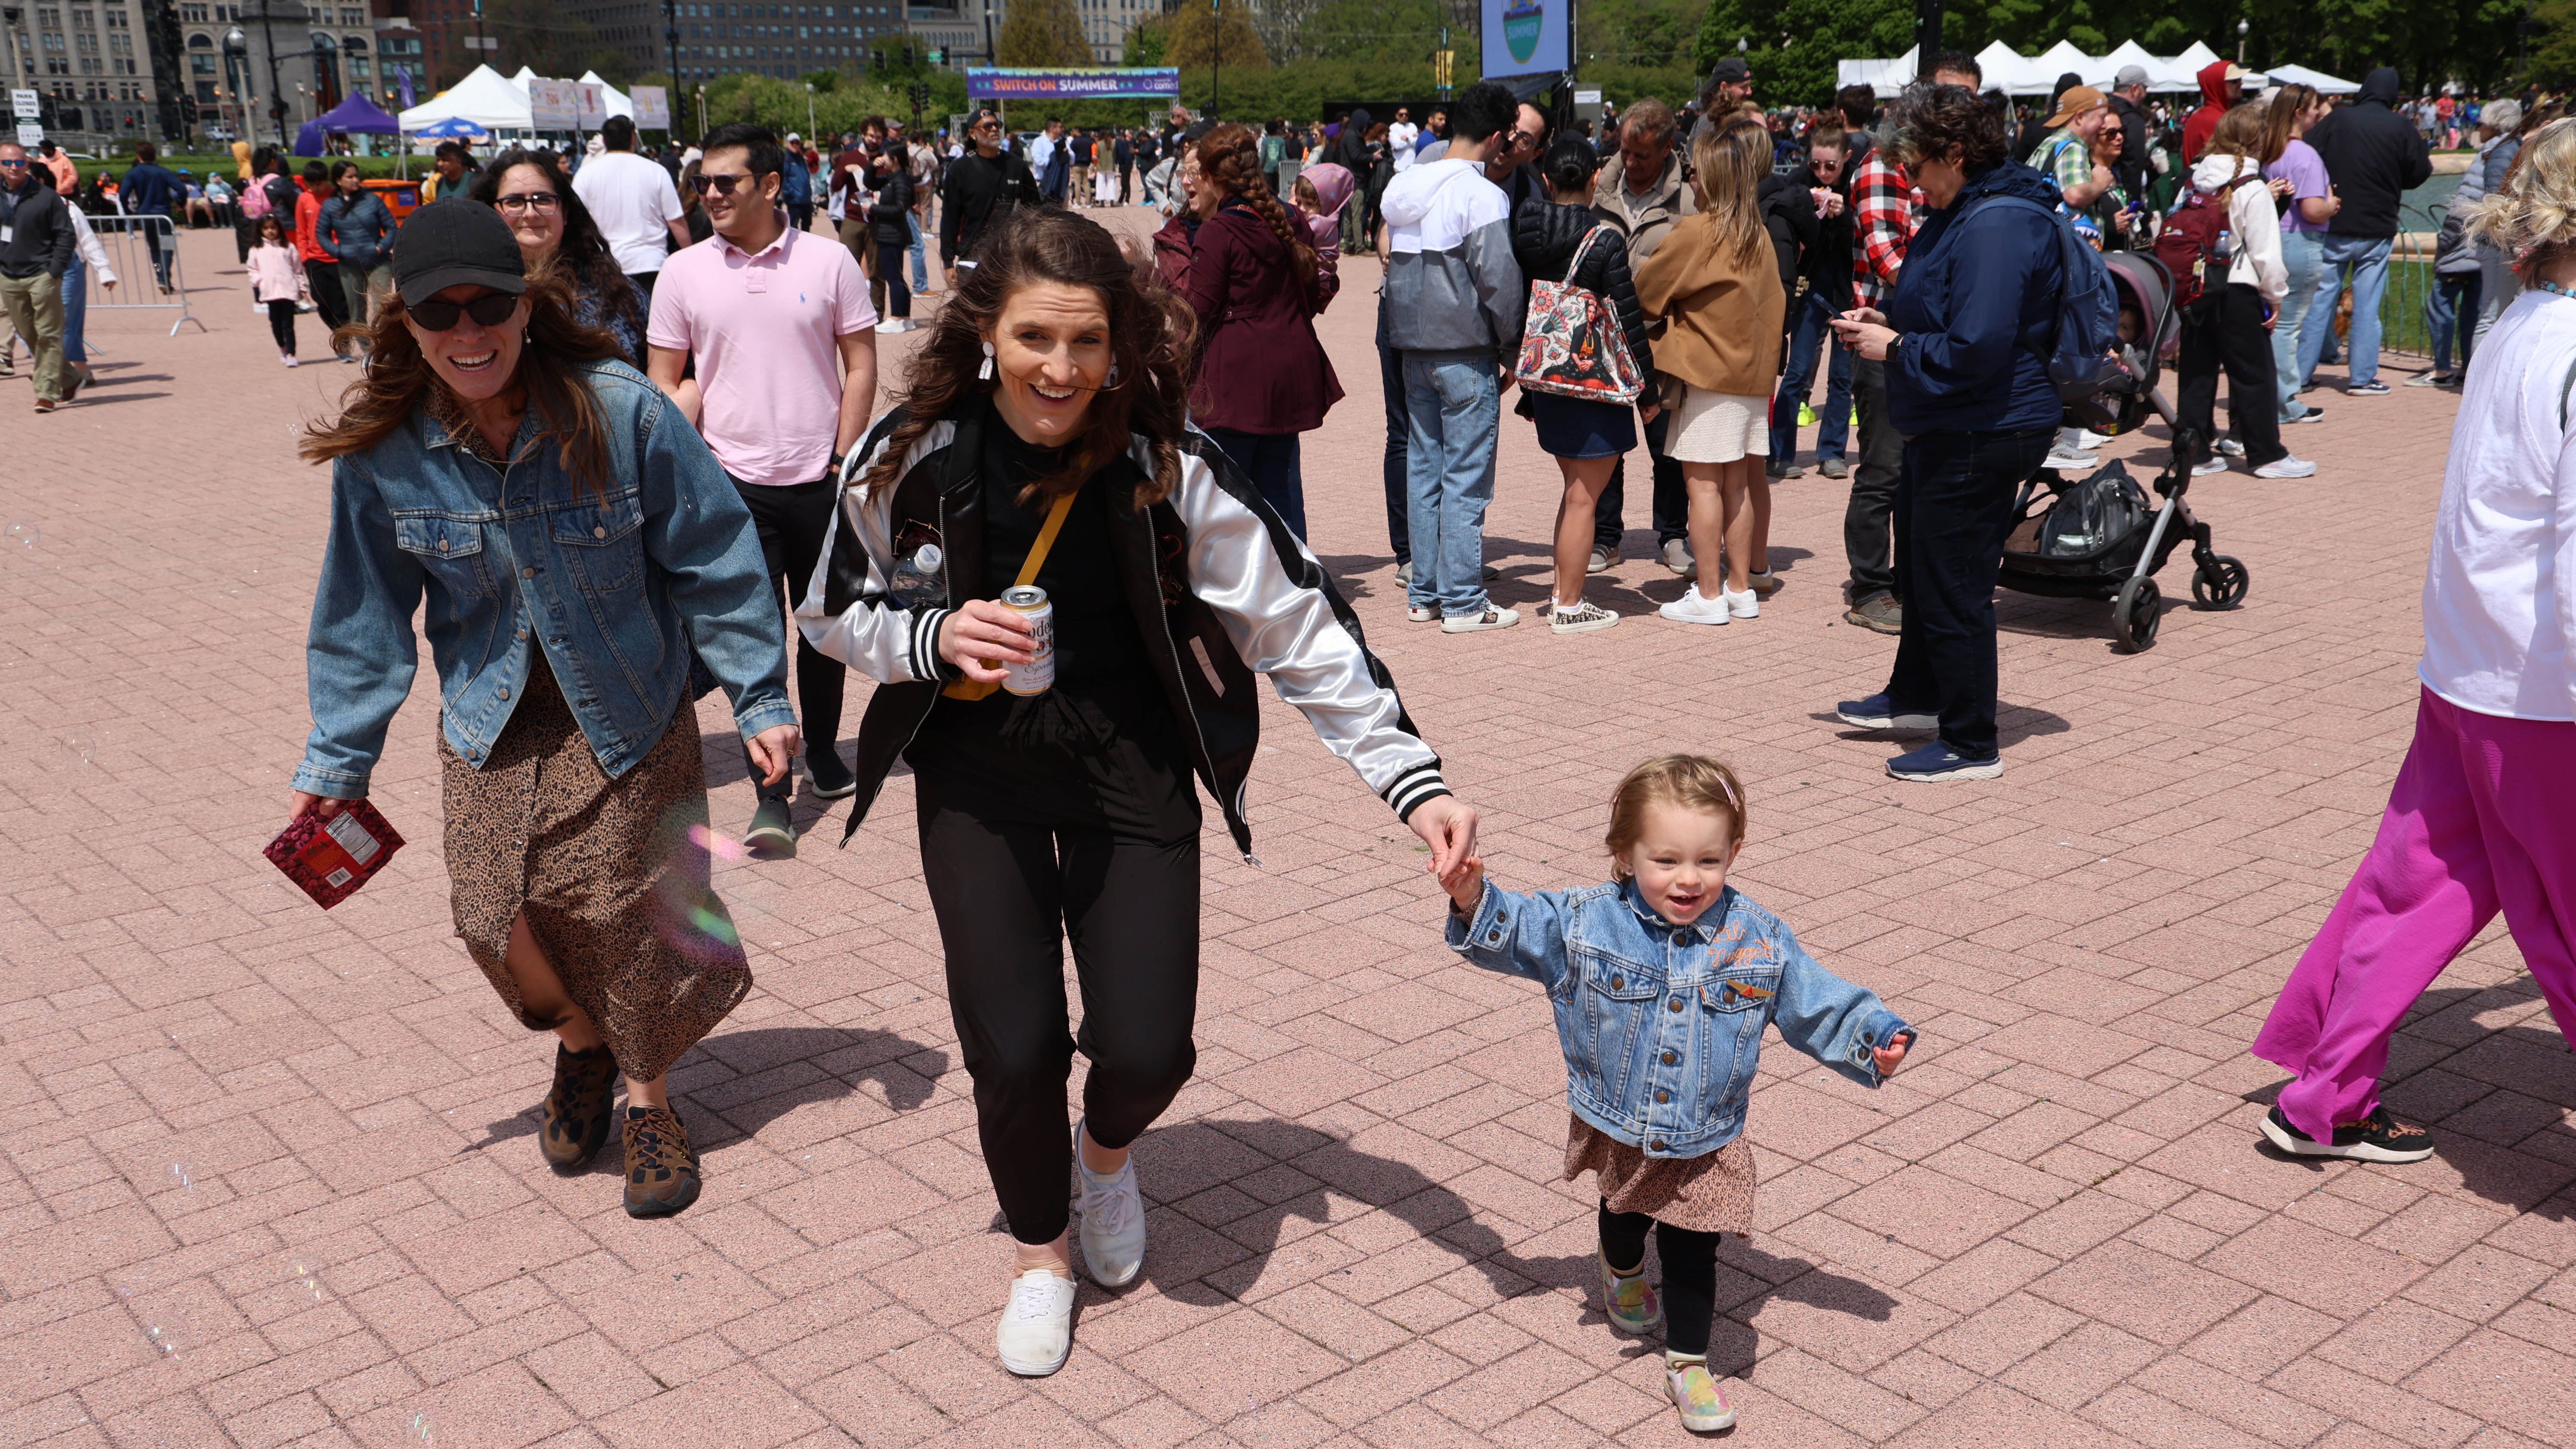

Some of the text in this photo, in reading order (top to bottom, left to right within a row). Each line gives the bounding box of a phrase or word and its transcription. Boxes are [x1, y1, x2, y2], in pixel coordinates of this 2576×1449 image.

[1507, 22, 1538, 40] SUMMER
[994, 79, 1118, 92] SWITCH ON SUMMER
[2057, 451, 2072, 460] HOKA
[1027, 615, 1053, 638] odel
[1712, 920, 1746, 944] Lil
[1708, 937, 1773, 967] Nugget
